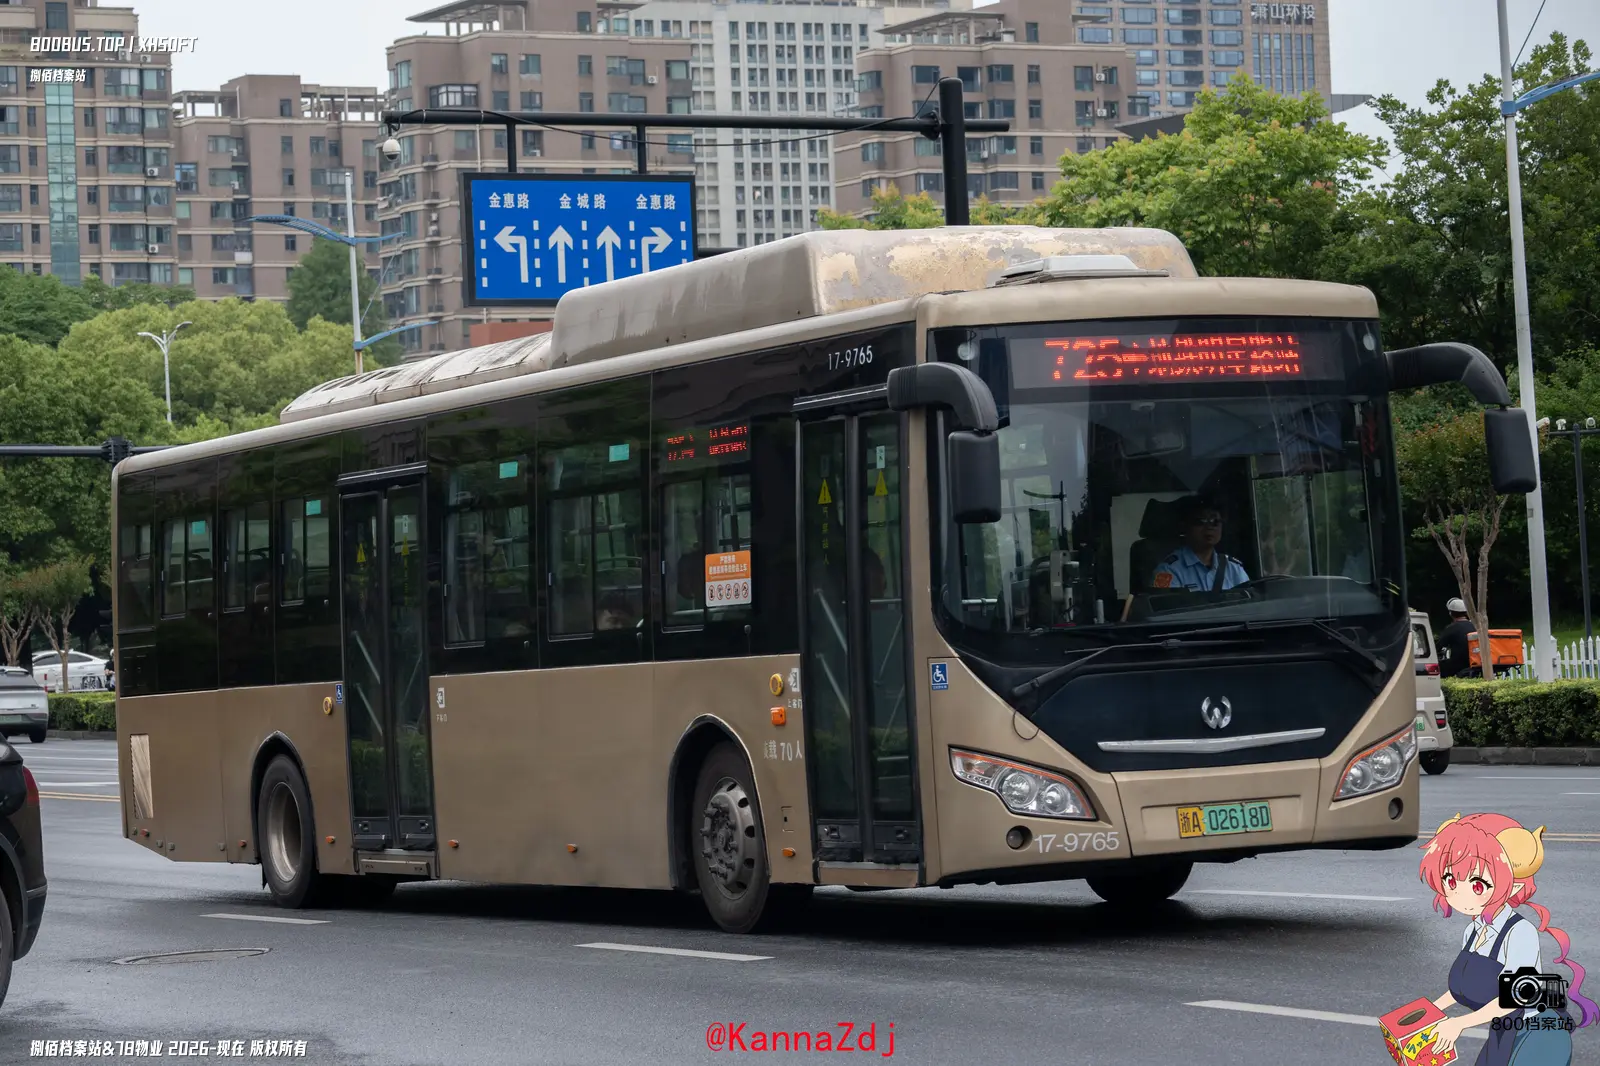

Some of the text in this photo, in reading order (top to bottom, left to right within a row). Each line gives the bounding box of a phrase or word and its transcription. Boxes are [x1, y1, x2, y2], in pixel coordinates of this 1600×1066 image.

[1251, 3, 1316, 20] 萧山环投
[489, 192, 529, 209] 金惠路
[559, 193, 606, 209] 金城路
[636, 194, 675, 210] 金惠路
[828, 345, 873, 370] 17-9765
[1034, 831, 1120, 854] 17-9765
